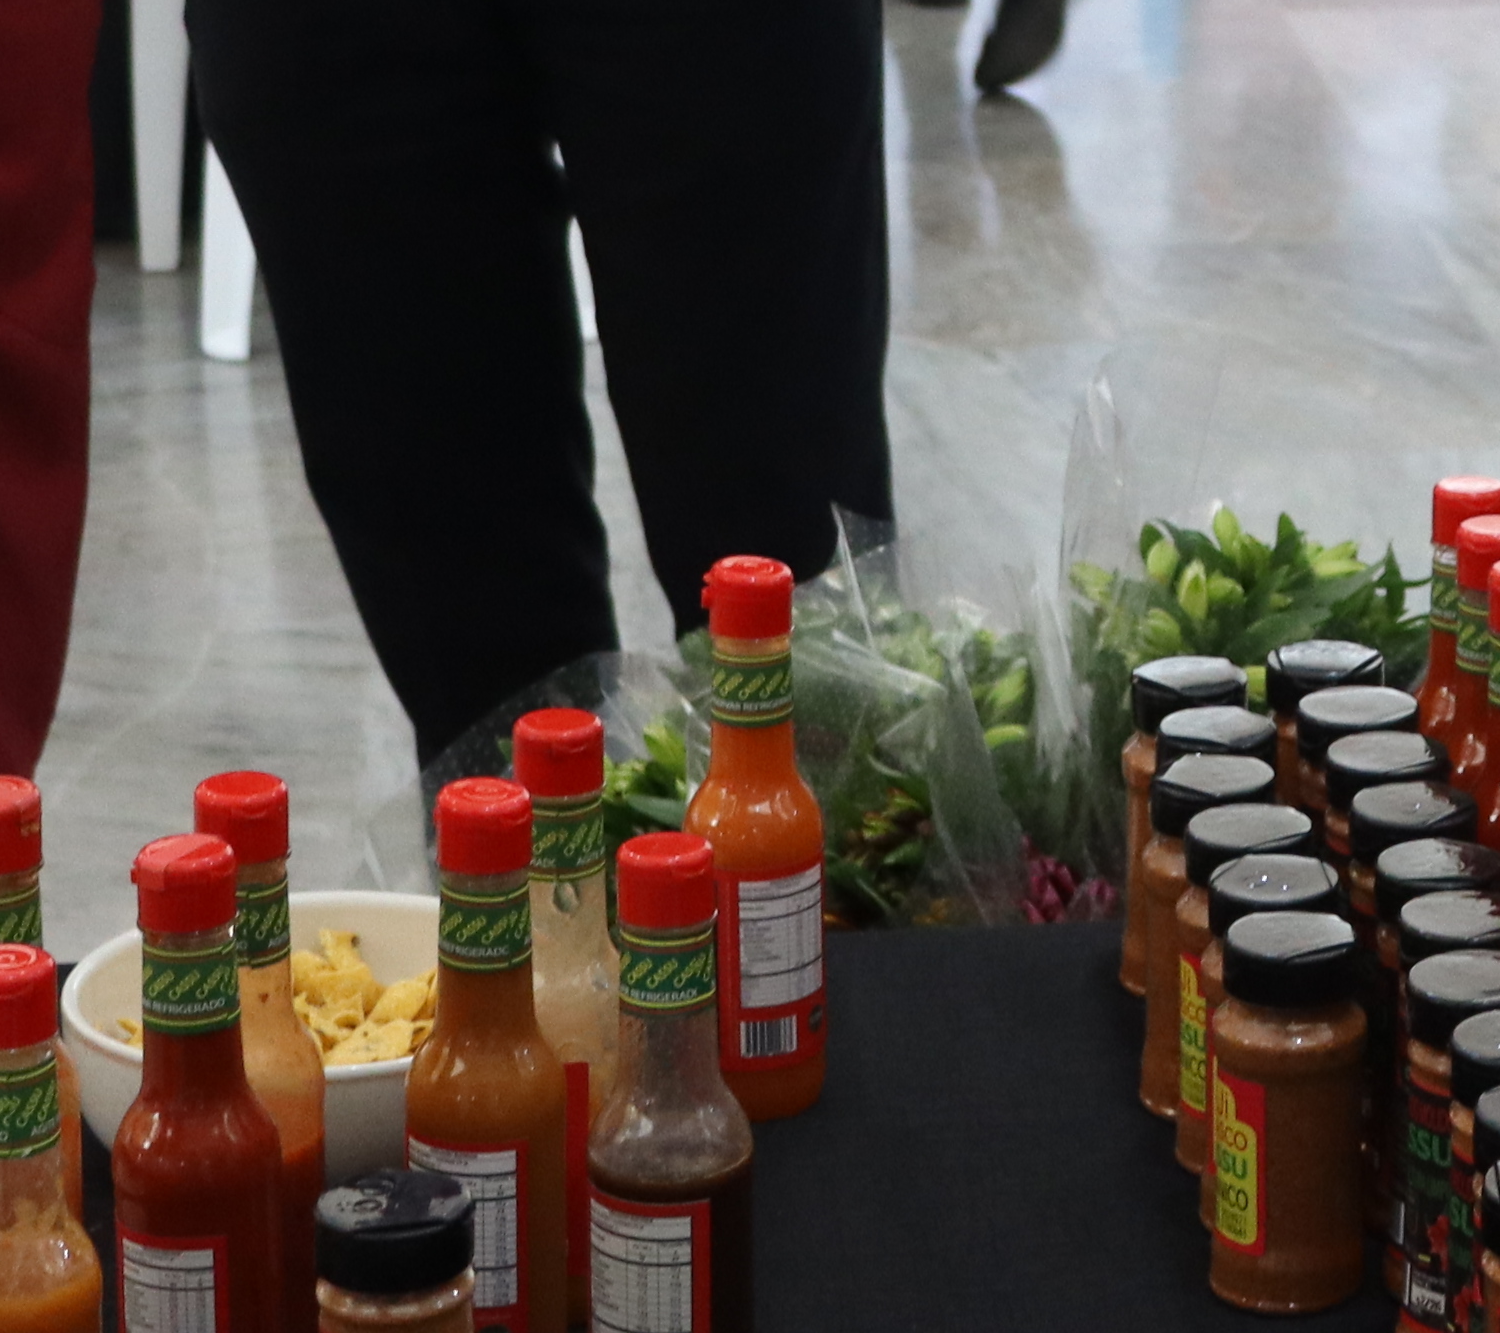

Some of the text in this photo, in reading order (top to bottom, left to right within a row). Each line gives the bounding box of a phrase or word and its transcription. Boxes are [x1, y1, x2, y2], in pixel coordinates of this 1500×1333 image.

[169, 970, 200, 1000] CASSU
[647, 958, 678, 989] CASSU
[153, 998, 225, 1015] REFRIGERADO
